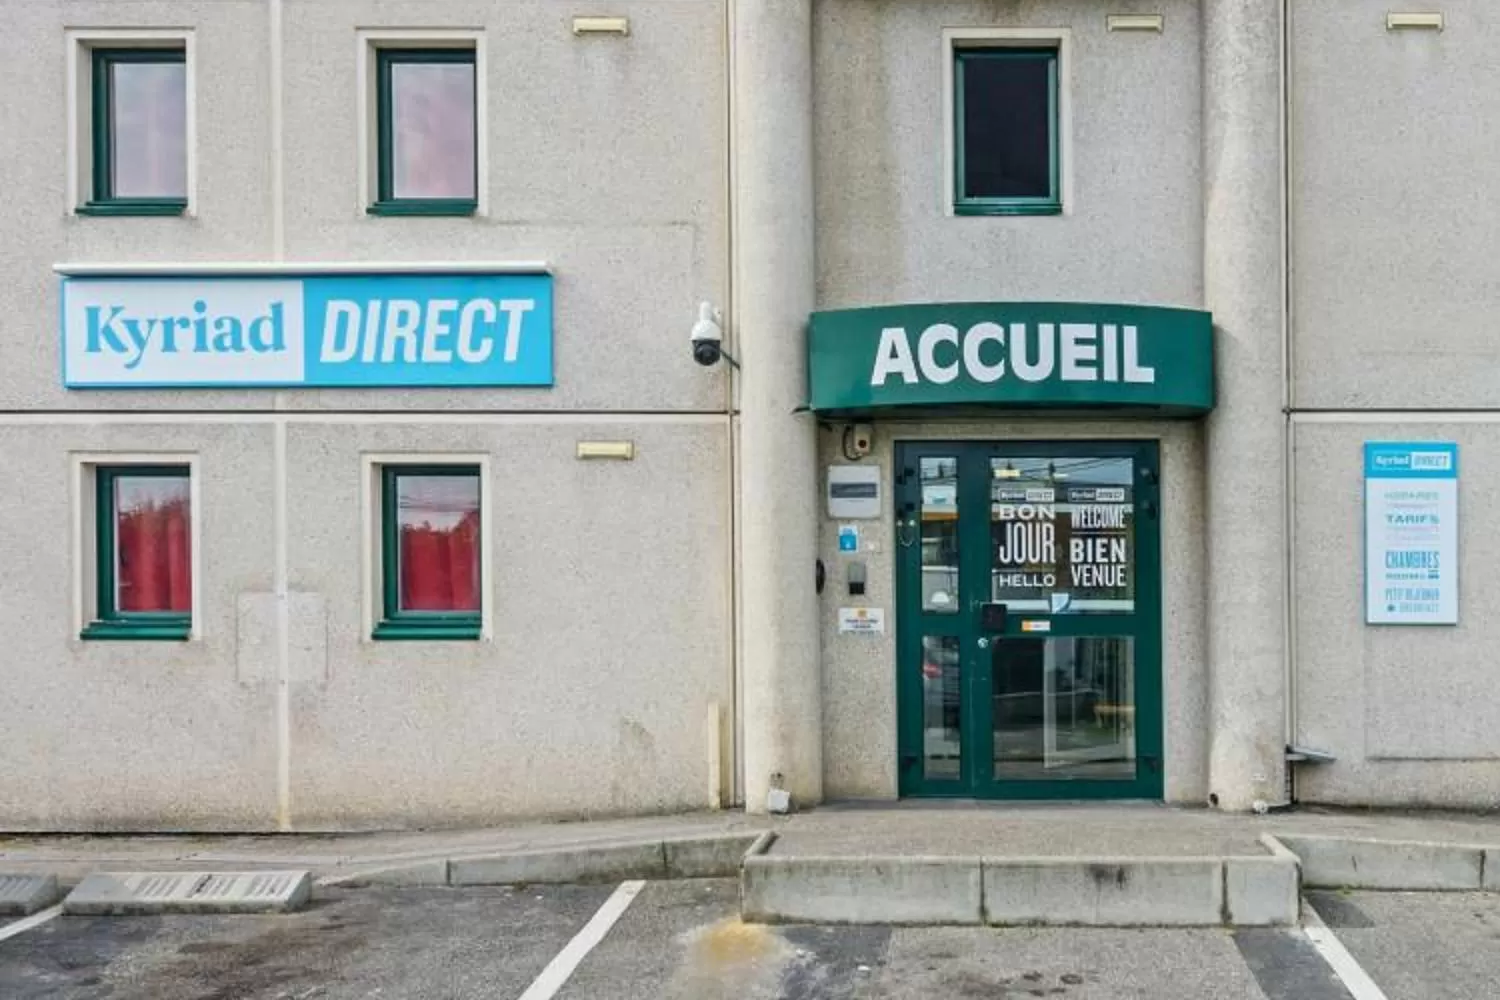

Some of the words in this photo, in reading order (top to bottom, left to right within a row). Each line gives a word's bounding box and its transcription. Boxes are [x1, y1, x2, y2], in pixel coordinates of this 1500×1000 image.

[83, 299, 287, 369] Kyriad
[319, 297, 534, 364] DIRECT
[870, 321, 1156, 386] ACCUEIL
[999, 504, 1056, 521] BON
[1071, 504, 1128, 530] WELCOME
[999, 522, 1056, 564] JOUR
[1070, 537, 1126, 563] BIEN
[1385, 551, 1440, 569] CHAMBRES
[999, 573, 1057, 587] HELLO
[1071, 563, 1127, 587] VENUE
